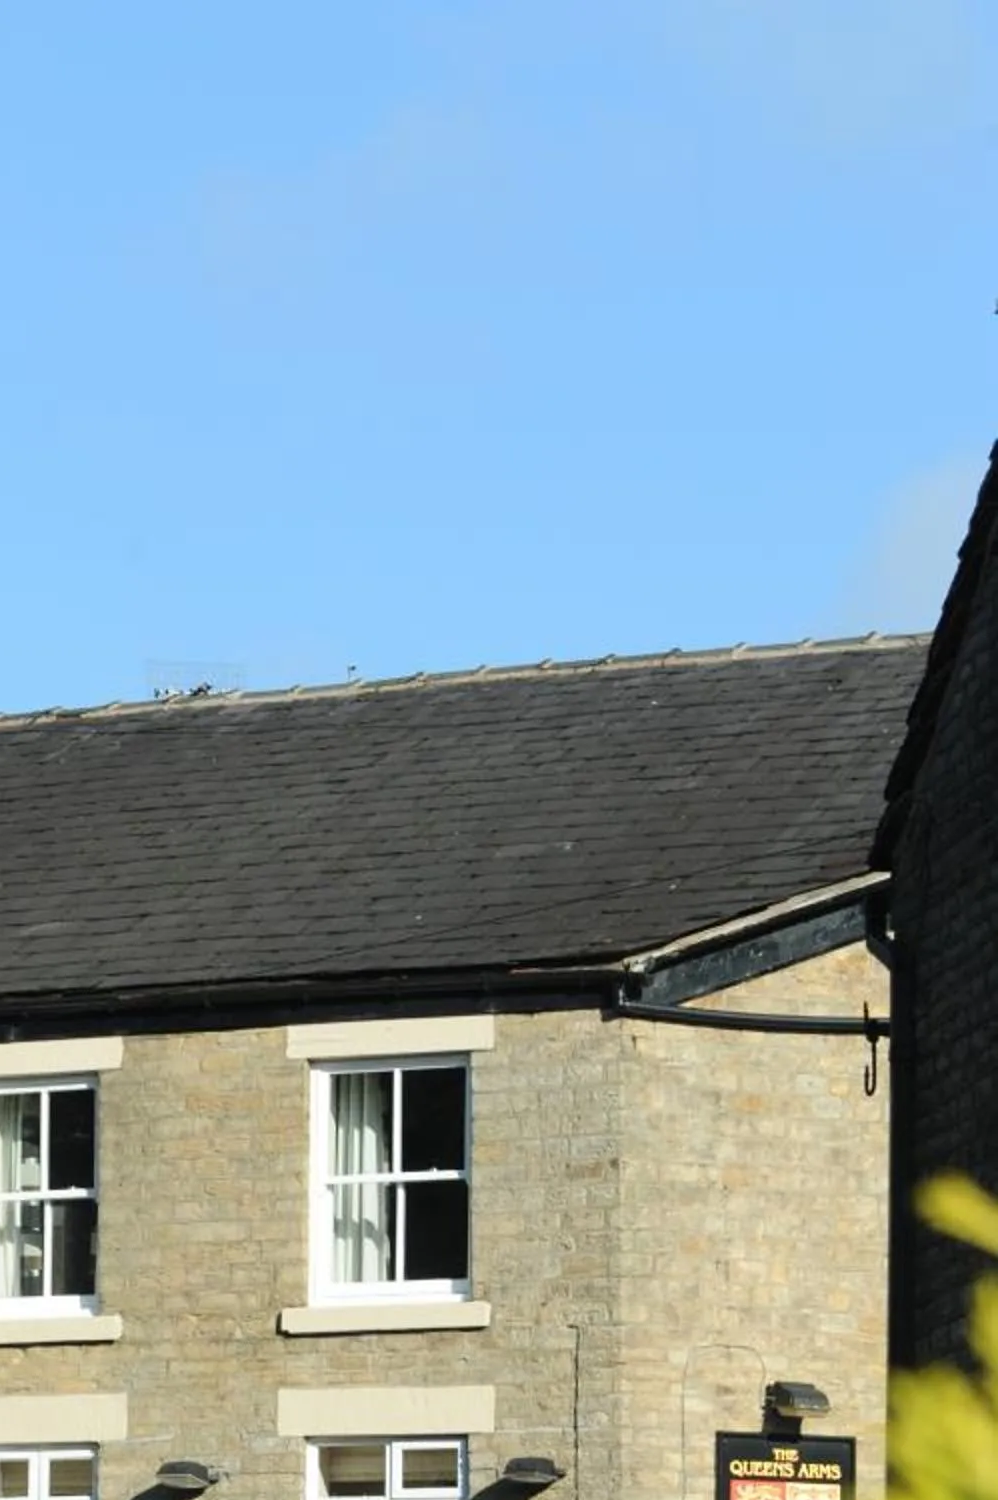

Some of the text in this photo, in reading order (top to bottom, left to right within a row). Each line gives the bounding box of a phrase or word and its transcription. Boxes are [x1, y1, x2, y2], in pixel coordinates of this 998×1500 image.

[772, 1448, 799, 1461] THE
[729, 1459, 841, 1480] QUEENS ARMS
